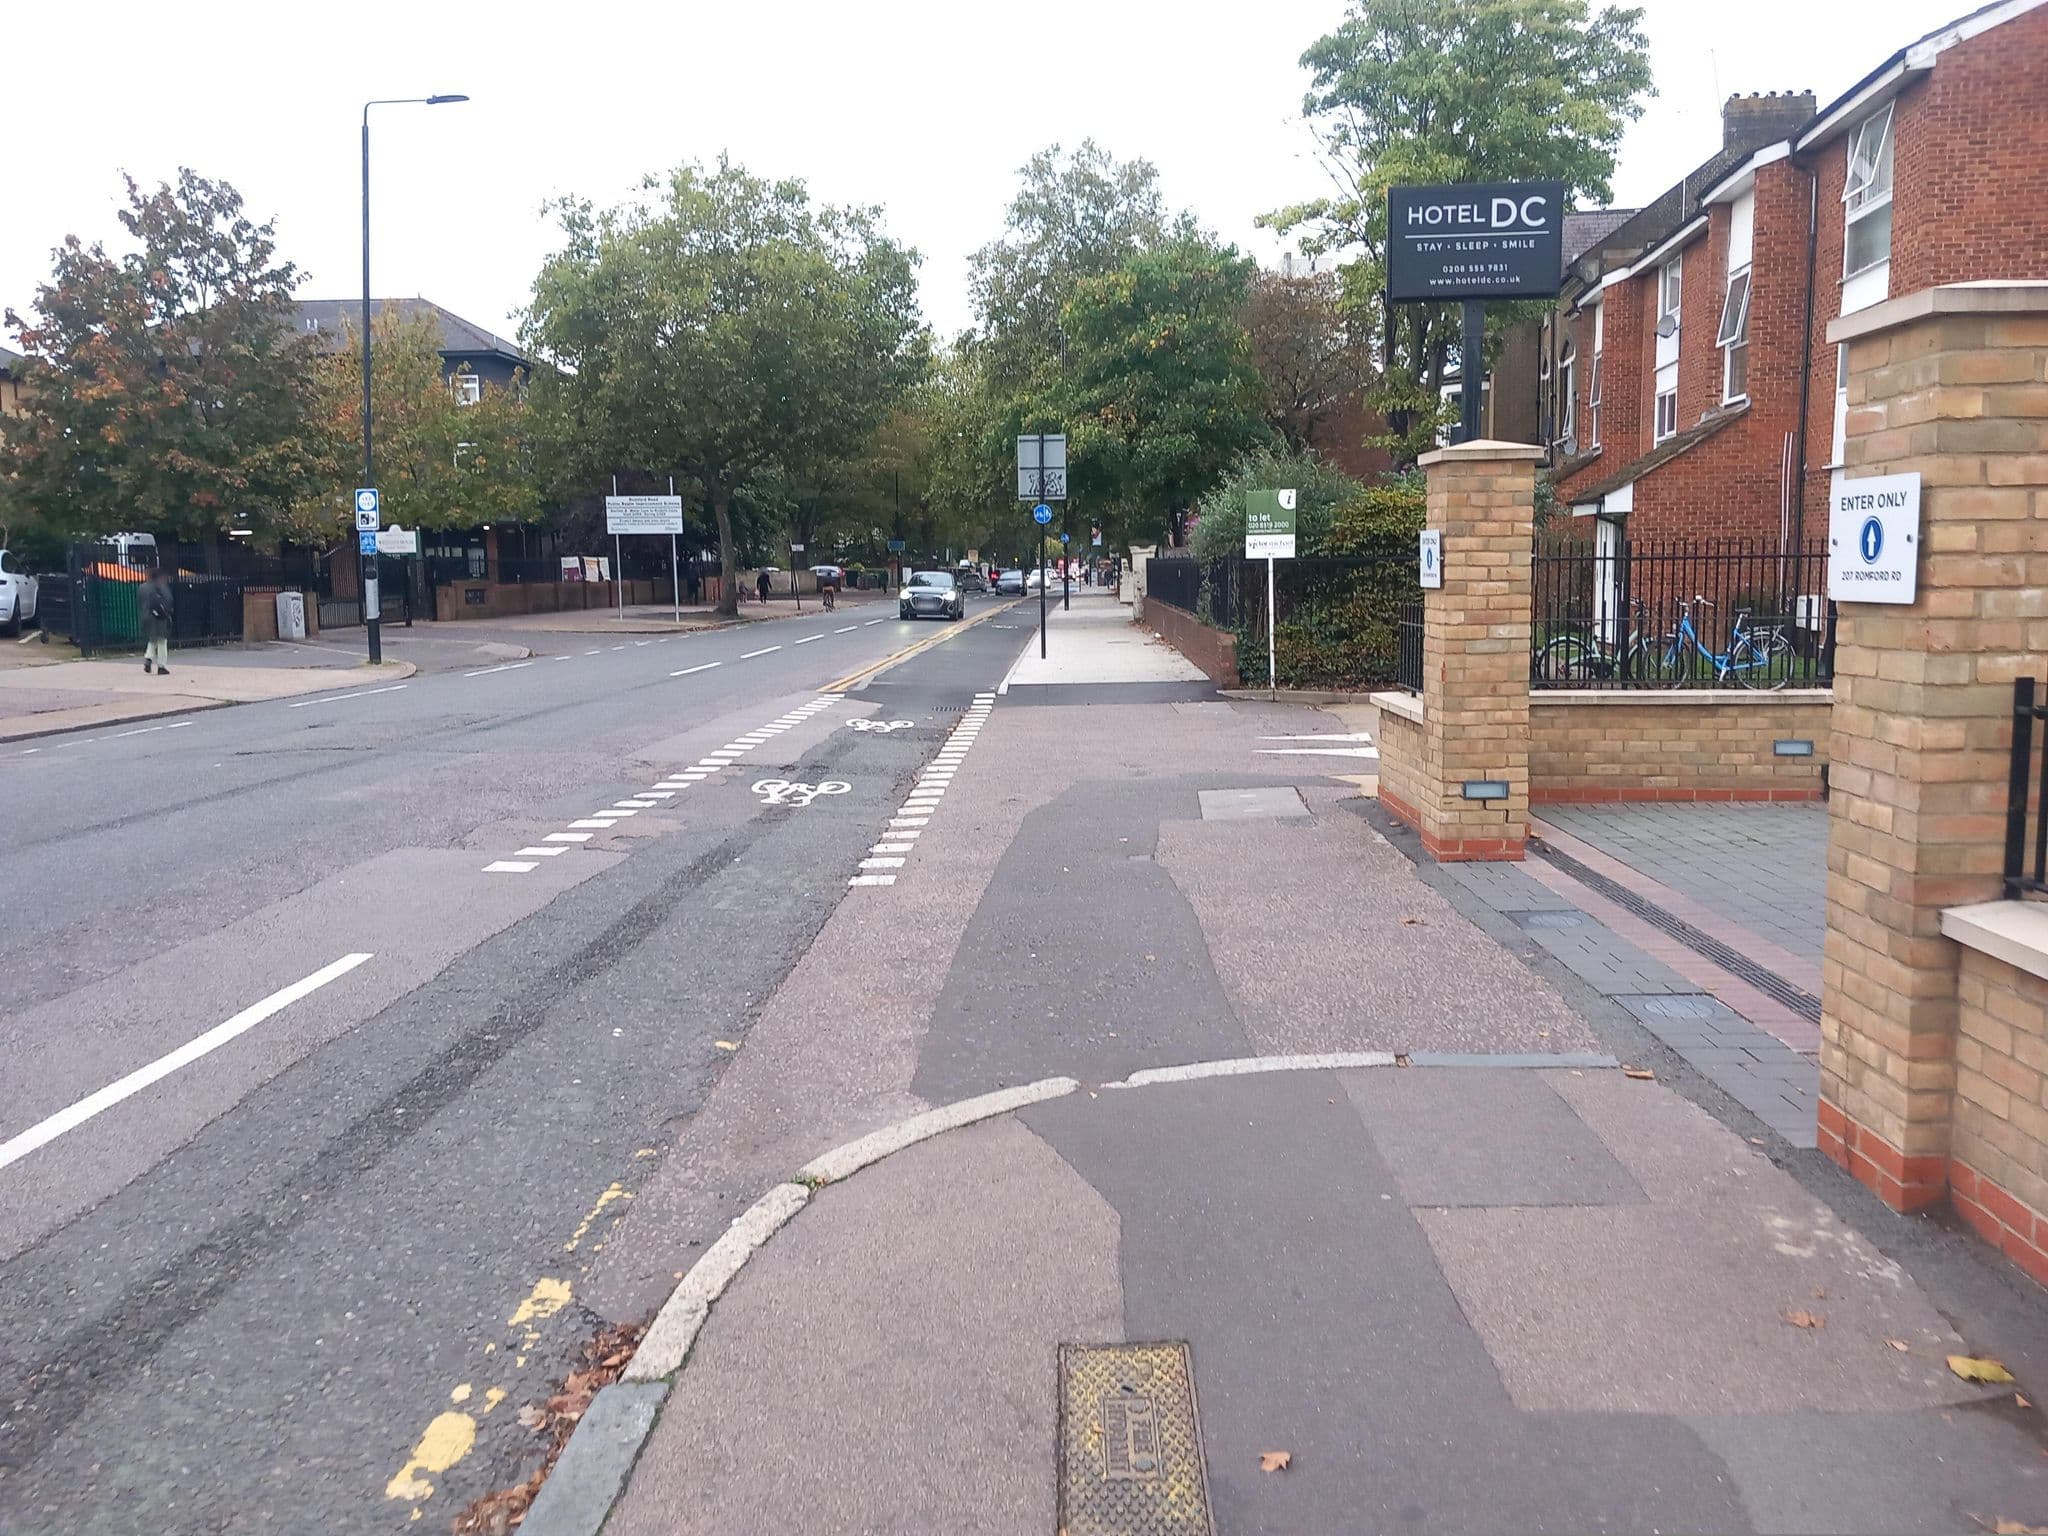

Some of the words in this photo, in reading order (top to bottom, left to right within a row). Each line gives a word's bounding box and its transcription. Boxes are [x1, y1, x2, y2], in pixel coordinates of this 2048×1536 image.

[1408, 204, 1486, 225] HOTEL
[1491, 196, 1547, 228] DC
[1416, 242, 1443, 252] STAY
[1455, 241, 1489, 251] SLEEP
[1502, 239, 1535, 249] SMILE
[1442, 264, 1465, 273] 0208
[1469, 264, 1485, 273] 555
[1429, 274, 1521, 286] www.hoteldc.co.uk
[1841, 494, 1874, 511] ENTER
[1878, 492, 1907, 508] ONLY
[1260, 512, 1270, 522] let
[1855, 571, 1889, 581] ROMFORD
[1891, 571, 1902, 581] RD
